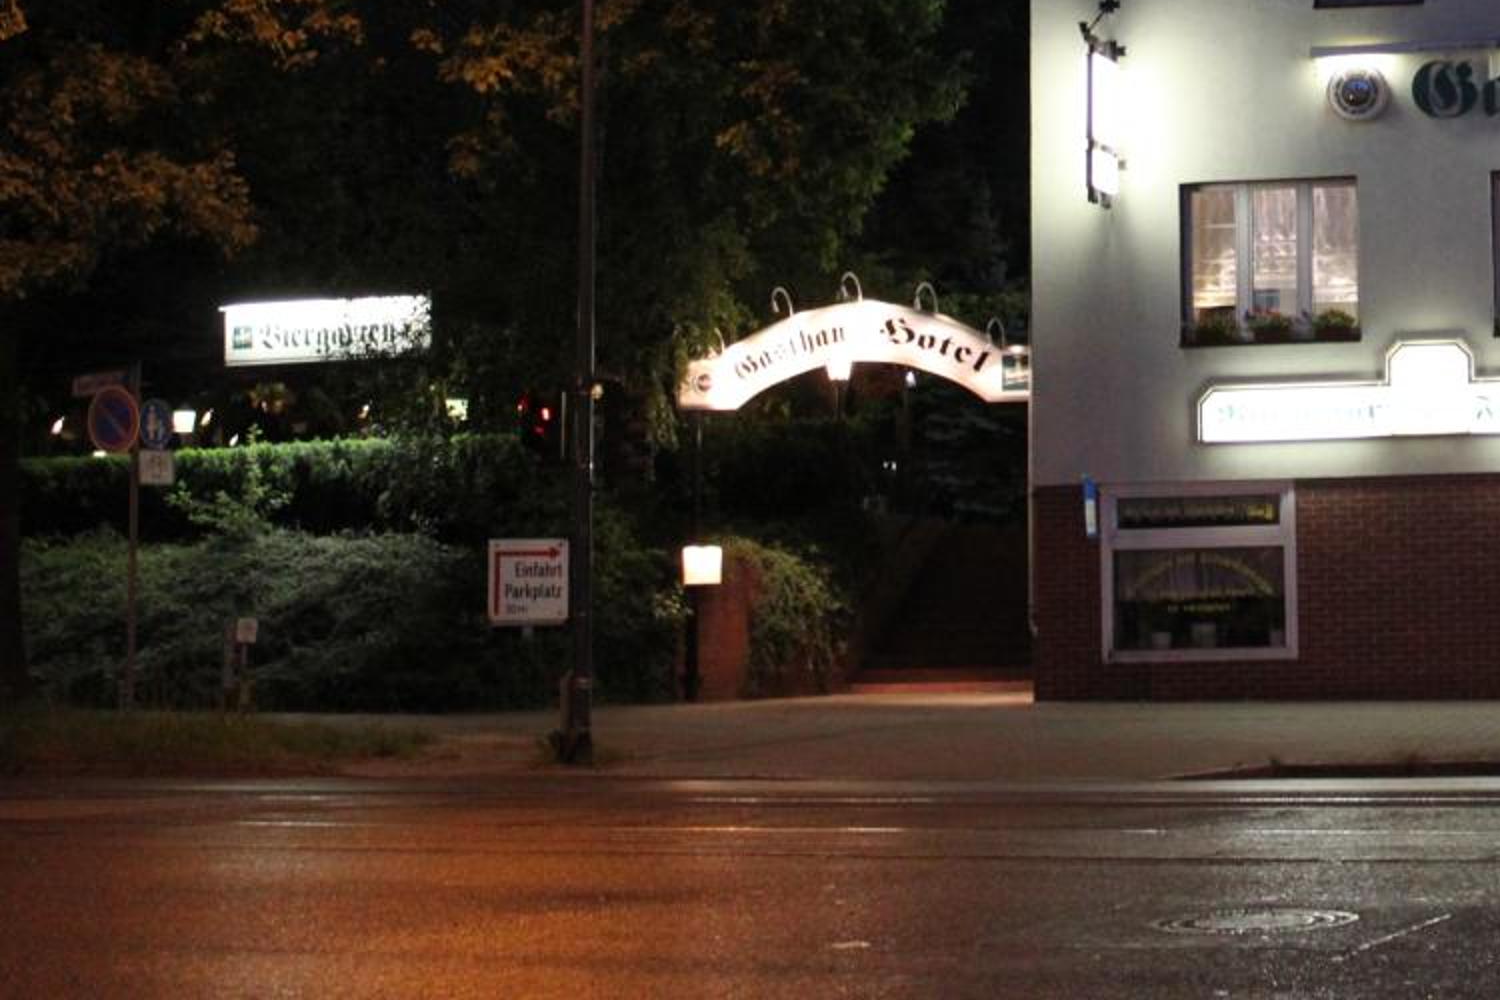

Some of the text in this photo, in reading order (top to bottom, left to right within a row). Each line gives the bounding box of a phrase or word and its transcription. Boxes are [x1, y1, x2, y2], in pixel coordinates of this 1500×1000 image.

[259, 321, 395, 354] Biergarten
[879, 317, 992, 373] Hotel
[514, 561, 563, 579] Einfahrt
[504, 582, 562, 601] Parkplatz
